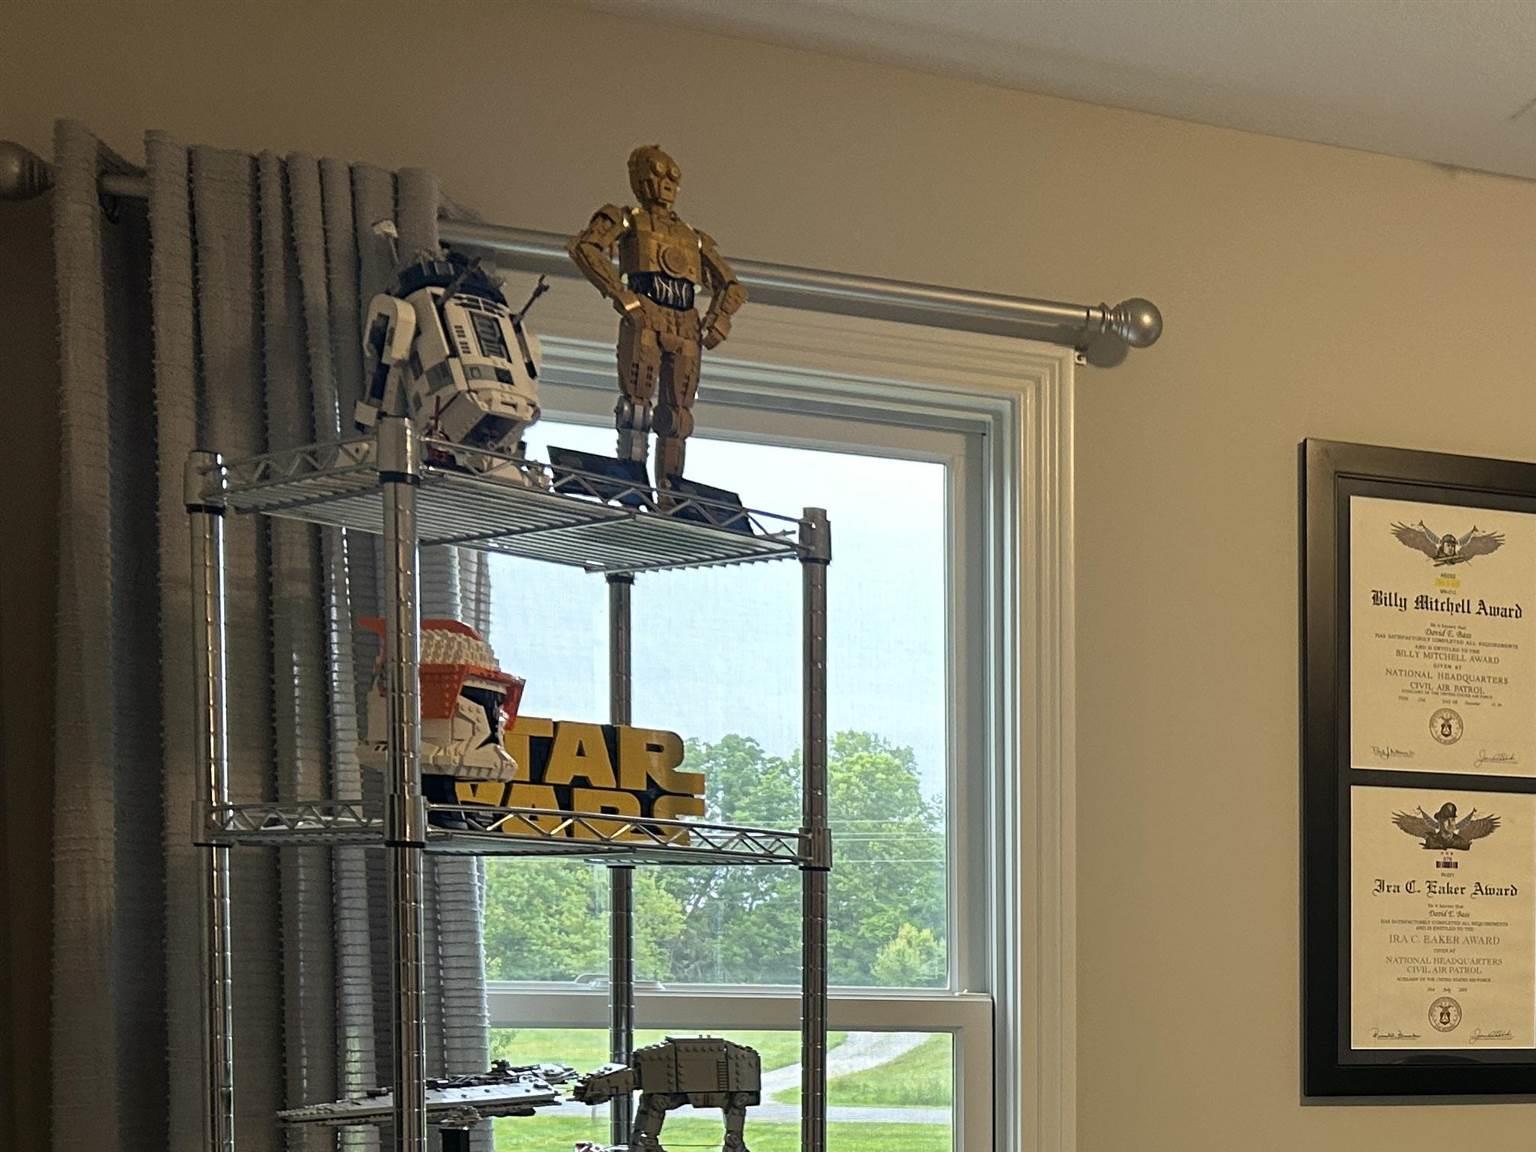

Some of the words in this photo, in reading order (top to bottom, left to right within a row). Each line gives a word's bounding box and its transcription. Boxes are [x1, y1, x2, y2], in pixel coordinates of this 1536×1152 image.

[1371, 589, 1407, 612] Billy
[1414, 595, 1471, 615] Mitchell
[1475, 599, 1523, 619] Award
[1395, 650, 1420, 659] BILLY
[1423, 651, 1466, 662] MITCHELL
[1469, 655, 1500, 665] AWARD
[1385, 668, 1433, 679] NATIONAL
[1437, 671, 1509, 685] HEADQUARTERS
[1410, 682, 1433, 691] CIVIL
[1436, 683, 1450, 692] AIR
[1454, 684, 1485, 695] PATROL
[503, 716, 706, 796] TAR
[1372, 878, 1401, 897] Ira
[1405, 879, 1421, 894] C.
[1425, 880, 1467, 898] Eaker
[1470, 881, 1518, 899] Award
[1389, 934, 1409, 944] IRA
[1410, 935, 1421, 945] C.
[1423, 935, 1460, 945] EAKER
[1462, 936, 1500, 945] AWARD
[1385, 956, 1432, 965] NATIONAL
[1433, 957, 1503, 967] HEADQUARTERS
[1406, 966, 1430, 974] CIVIL
[1449, 967, 1482, 975] PATROL
